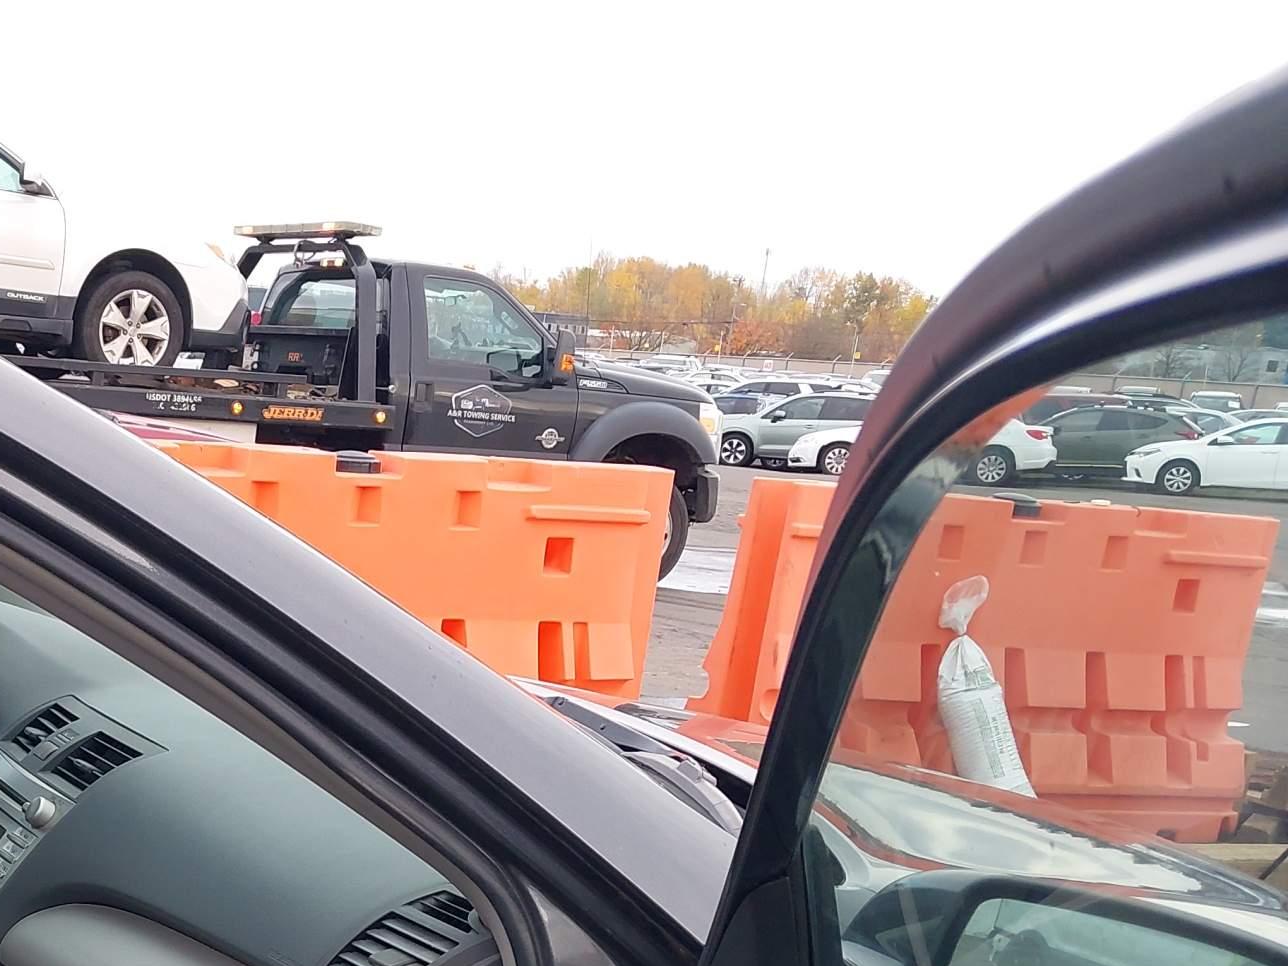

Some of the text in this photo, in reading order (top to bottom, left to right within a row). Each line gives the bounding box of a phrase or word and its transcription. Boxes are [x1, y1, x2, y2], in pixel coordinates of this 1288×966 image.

[7, 292, 45, 302] OUTBACK
[463, 410, 489, 420] TOWING
[490, 413, 516, 423] SERVICE
